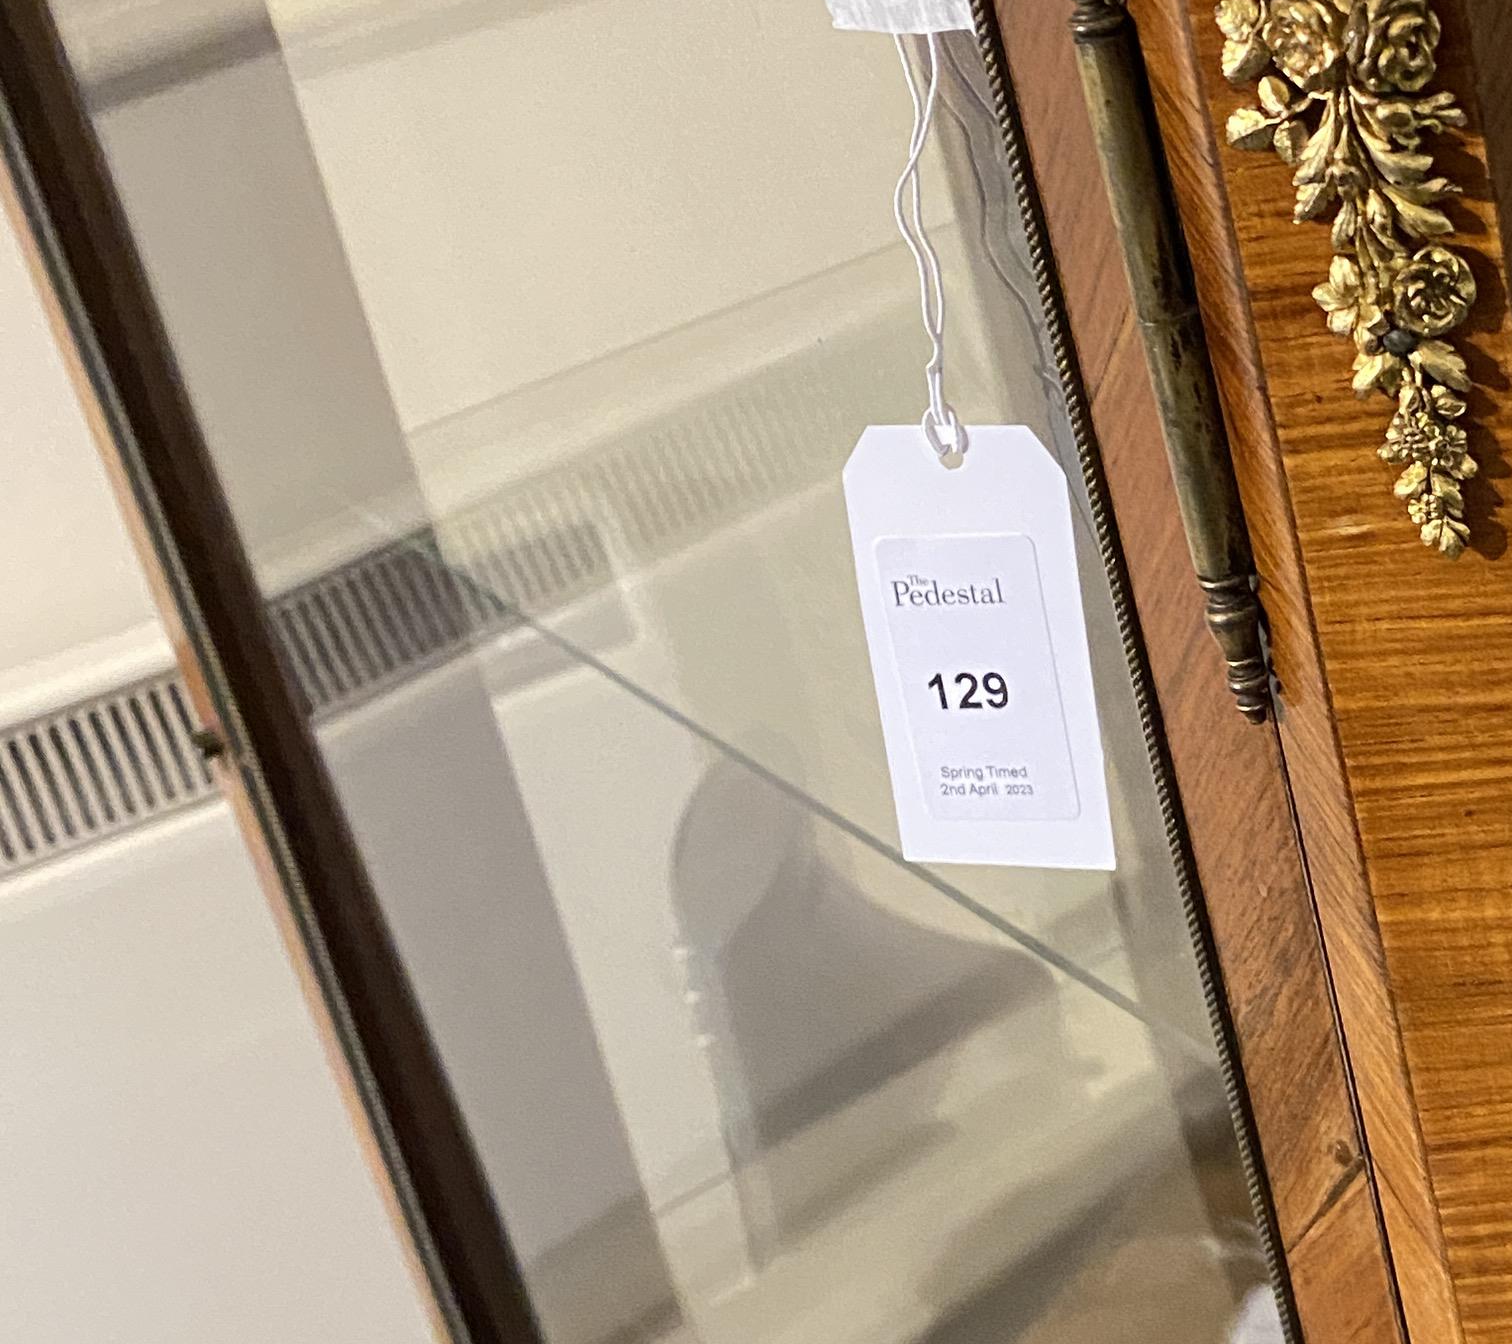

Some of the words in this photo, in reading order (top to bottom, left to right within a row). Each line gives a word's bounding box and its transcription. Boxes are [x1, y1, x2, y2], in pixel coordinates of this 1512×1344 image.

[907, 574, 930, 586] The
[890, 577, 1007, 607] Pedestal
[928, 672, 1008, 709] 129
[940, 765, 984, 782] Spring
[985, 765, 1028, 779] Timed
[940, 782, 966, 796] 2nd
[969, 782, 999, 797] April
[1005, 784, 1034, 796] 2023
